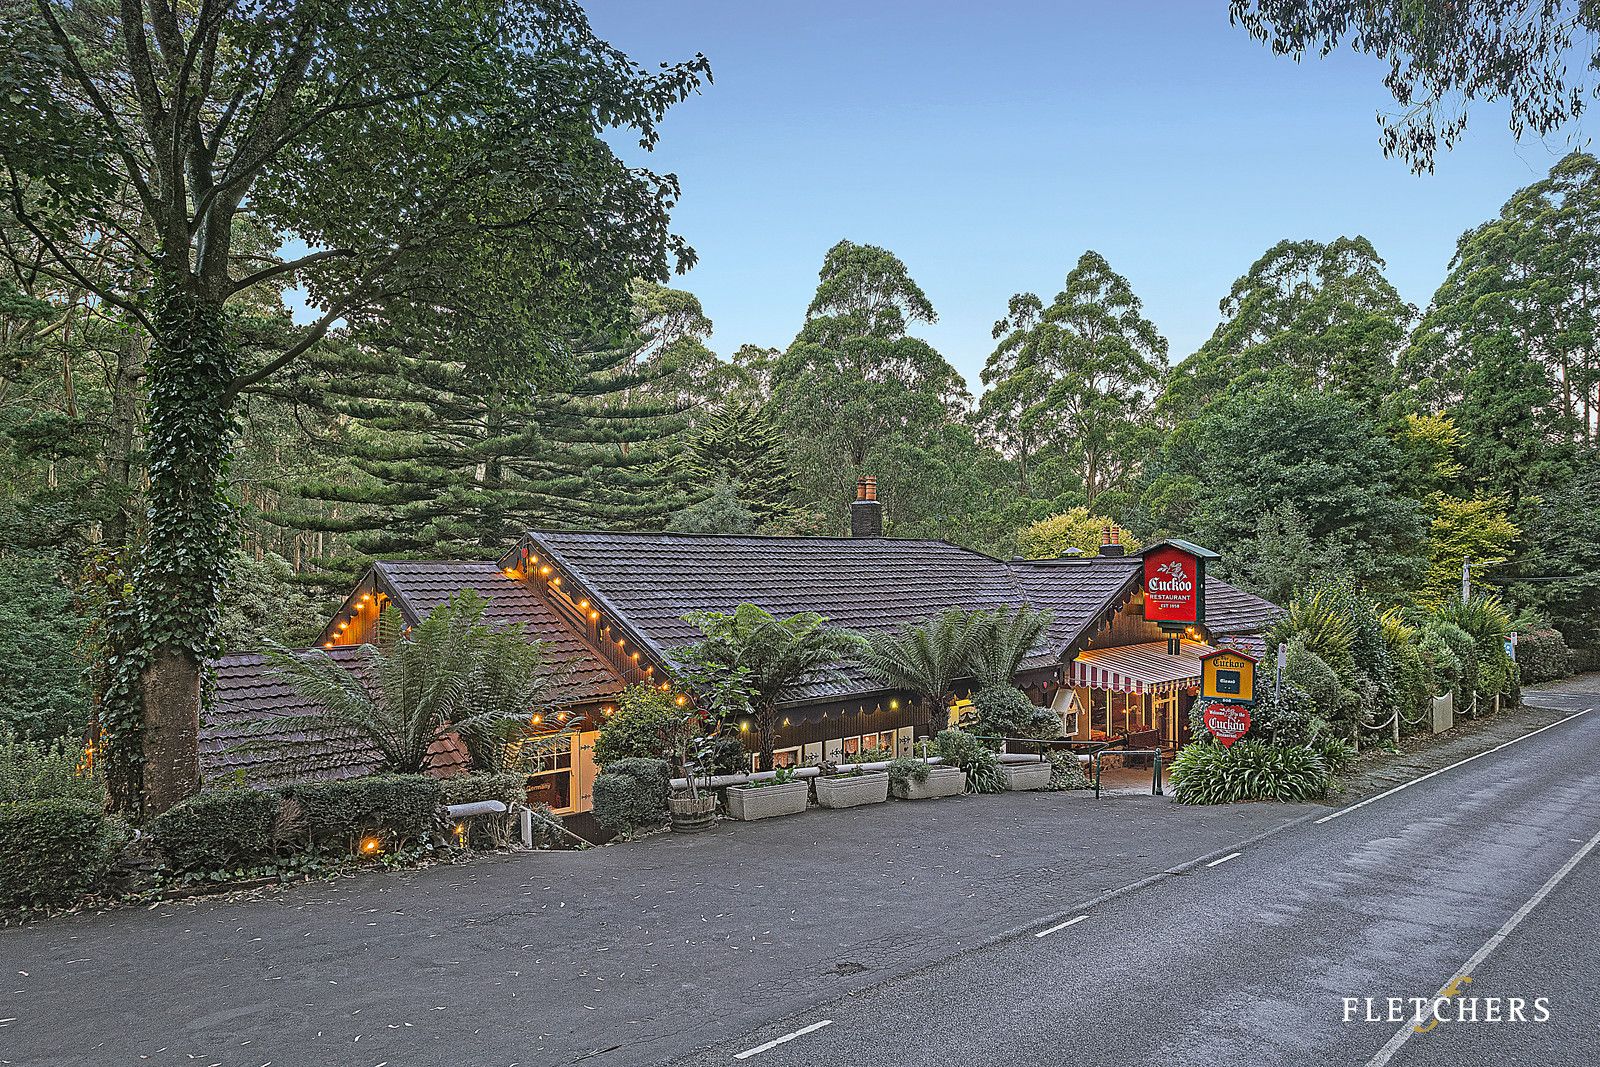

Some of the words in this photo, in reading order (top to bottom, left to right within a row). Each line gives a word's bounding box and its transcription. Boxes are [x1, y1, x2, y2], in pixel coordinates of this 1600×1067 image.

[1148, 577, 1192, 593] Cuckoo
[1212, 658, 1245, 668] Cuckoo
[1208, 717, 1245, 730] Cuckoo
